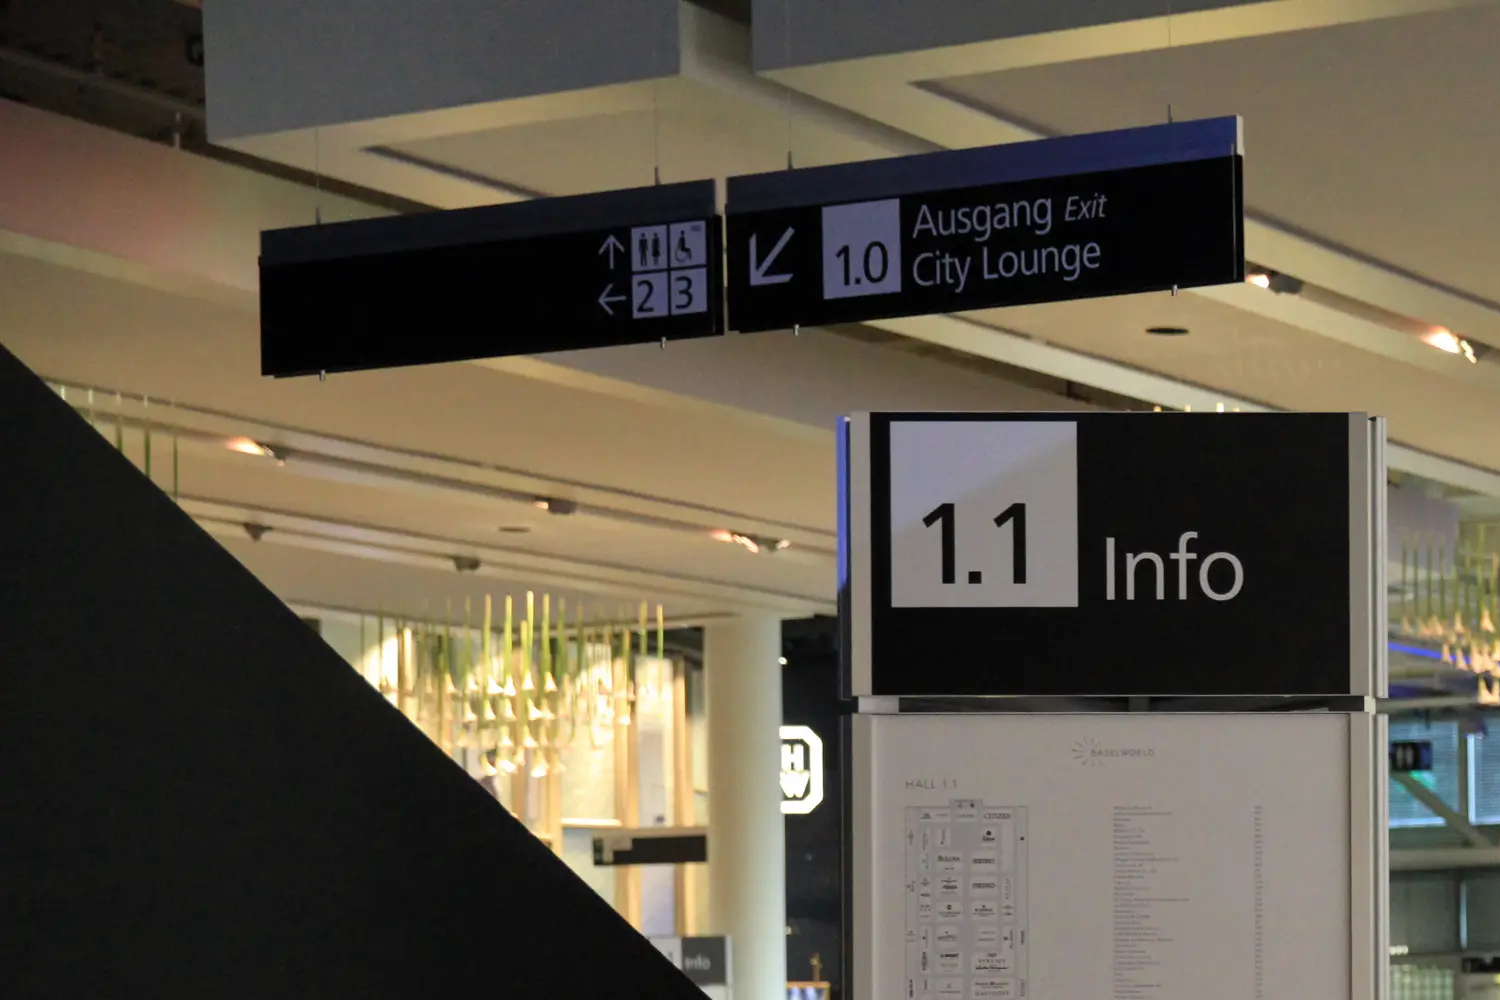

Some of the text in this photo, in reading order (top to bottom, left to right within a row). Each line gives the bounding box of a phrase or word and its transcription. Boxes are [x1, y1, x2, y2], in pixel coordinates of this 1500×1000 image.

[912, 192, 1108, 241] Ausgang Exit
[834, 241, 889, 287] 1.0
[912, 240, 1101, 293] City Lounge
[635, 275, 695, 314] 2 3
[922, 502, 1244, 601] 1.1 Info
[905, 778, 938, 790] HALL
